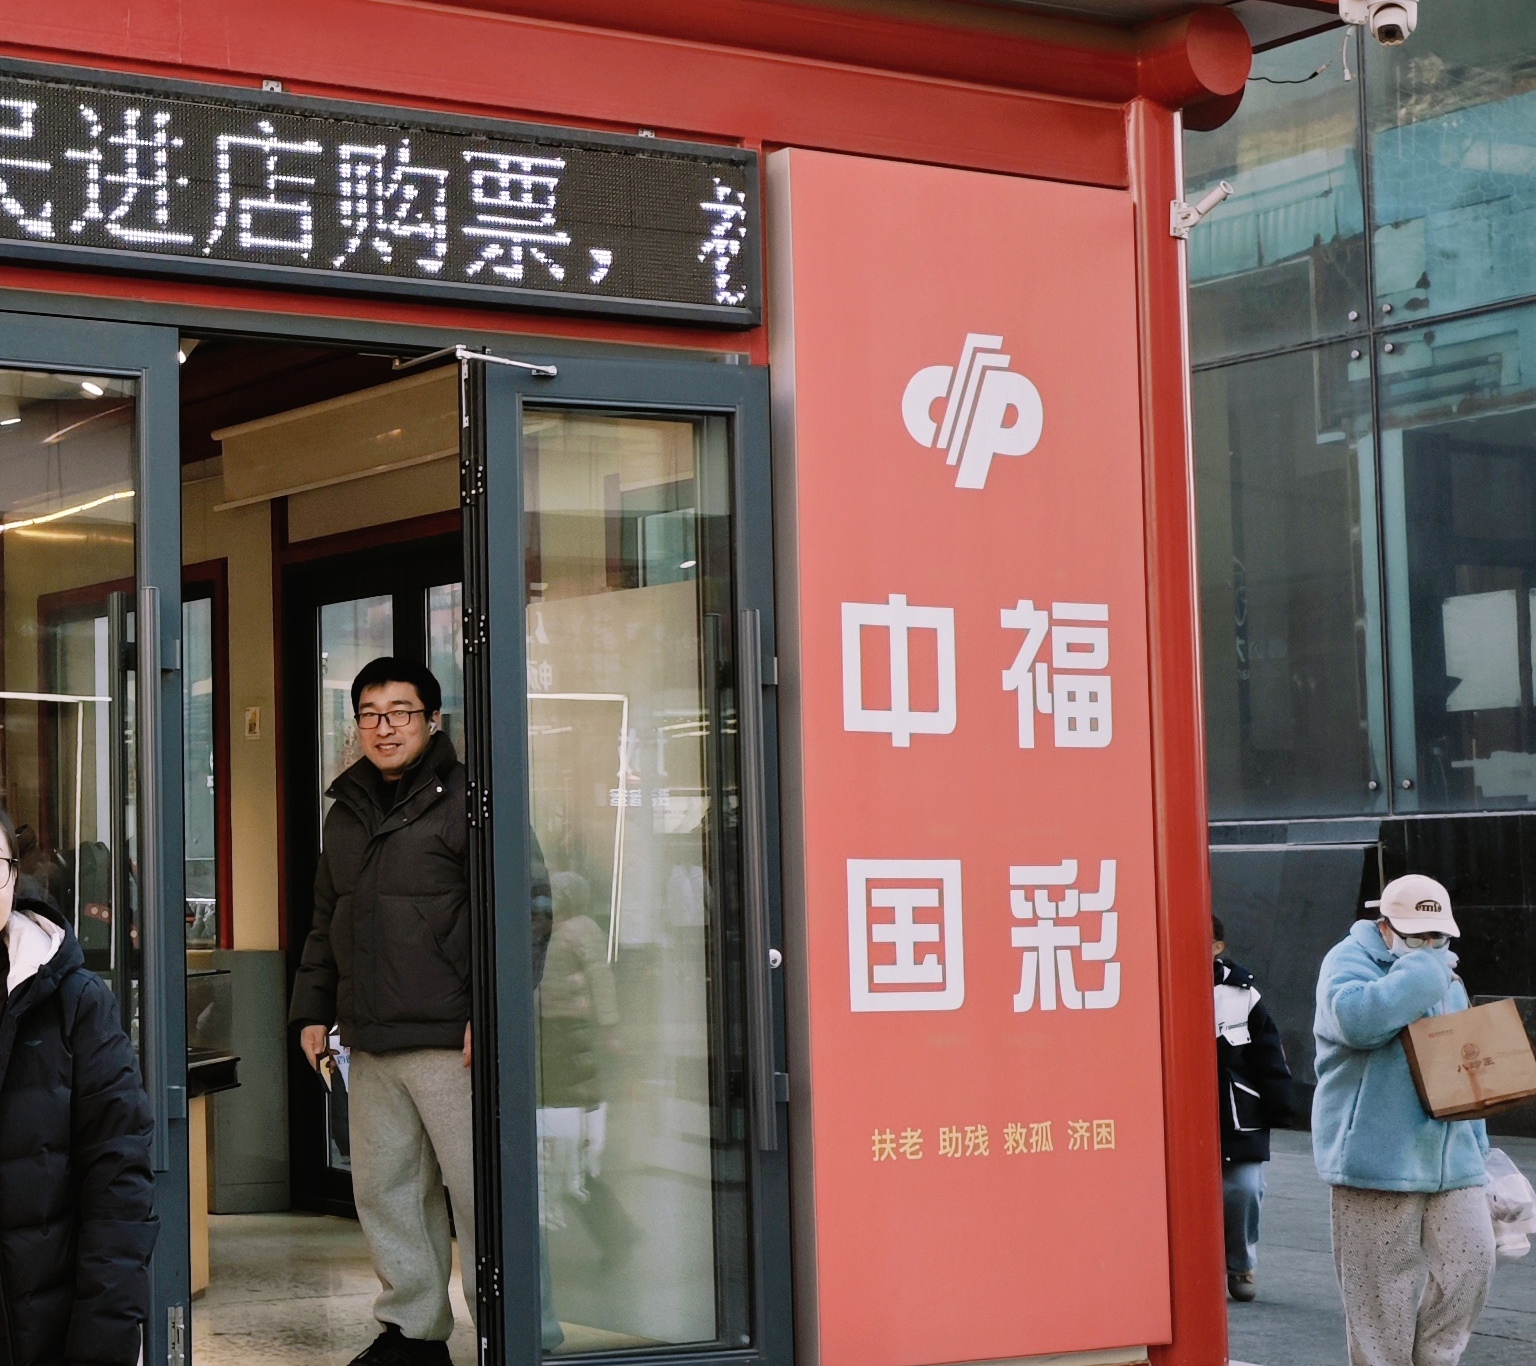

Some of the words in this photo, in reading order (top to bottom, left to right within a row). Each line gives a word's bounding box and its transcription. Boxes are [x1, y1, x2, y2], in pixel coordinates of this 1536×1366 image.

[871, 1128, 923, 1161] 扶老
[938, 1125, 989, 1158] 助残
[1003, 1120, 1053, 1155] 救孤
[1067, 1119, 1116, 1151] 济困
